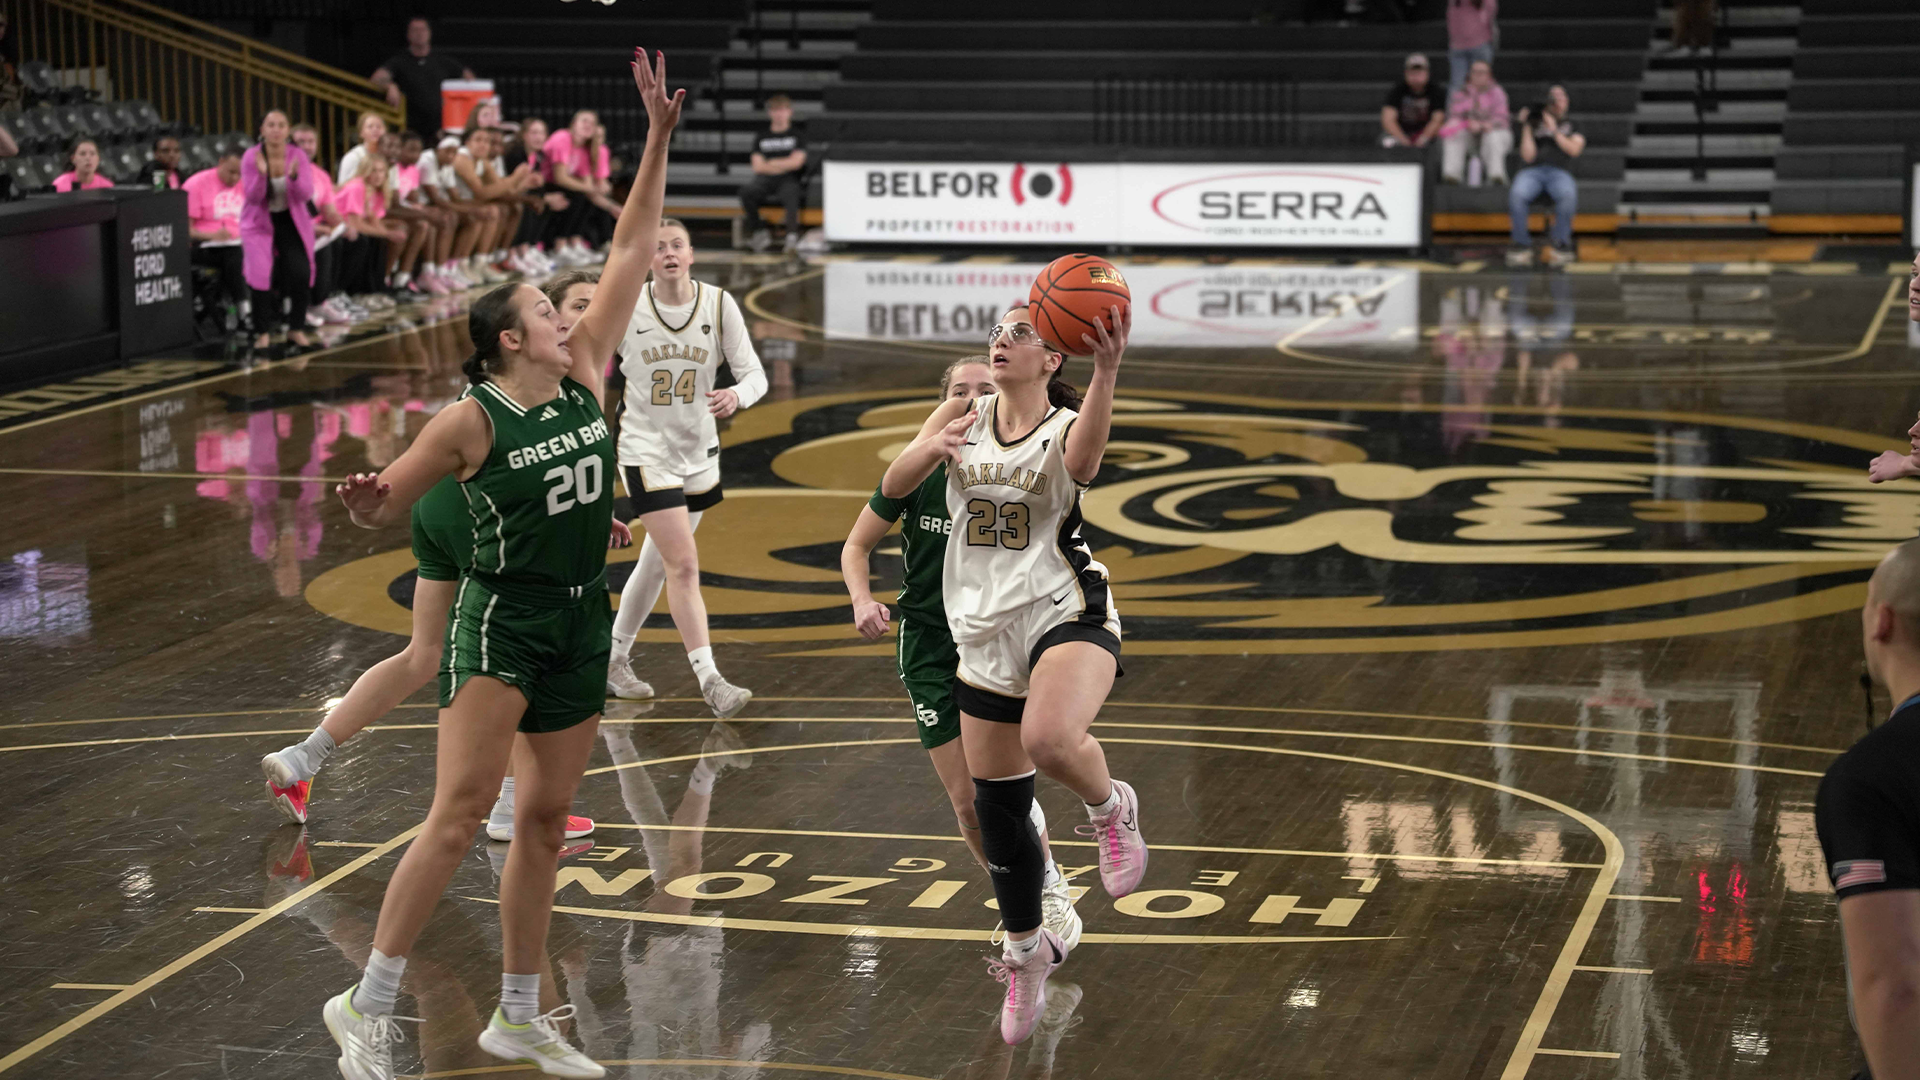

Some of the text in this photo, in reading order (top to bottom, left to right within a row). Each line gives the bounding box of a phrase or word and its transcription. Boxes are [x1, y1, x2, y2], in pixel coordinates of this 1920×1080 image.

[867, 172, 998, 198] BELFOR
[1200, 191, 1388, 220] SERRA
[131, 224, 173, 251] HENRY
[134, 252, 166, 279] FORD
[641, 344, 709, 365] OAKLAND
[651, 369, 696, 406] 24
[507, 432, 579, 470] GREEN
[543, 454, 602, 516] 20
[956, 463, 1048, 496] OAKLAND
[966, 497, 1031, 552] 23
[554, 866, 1367, 927] HOIZON
